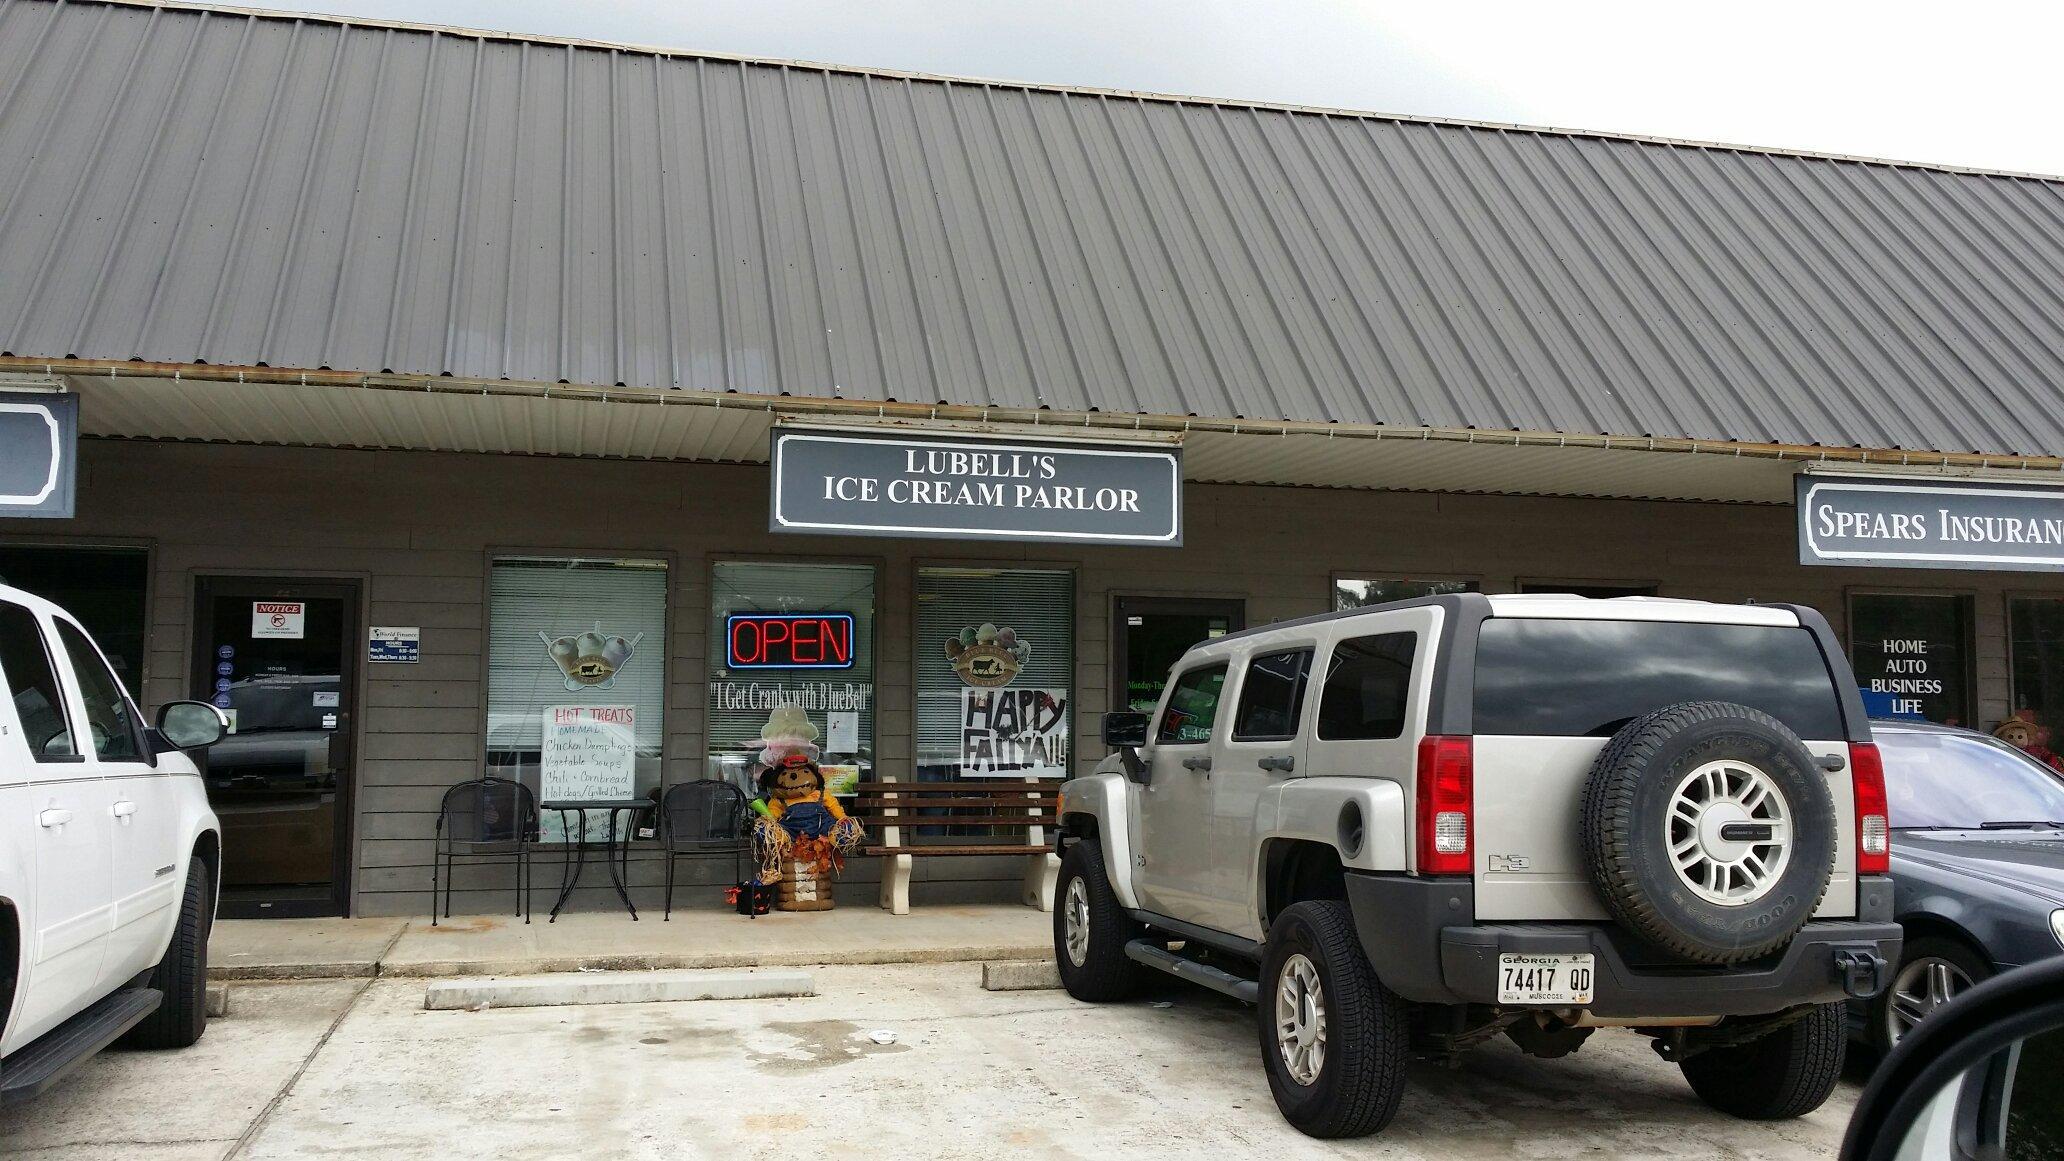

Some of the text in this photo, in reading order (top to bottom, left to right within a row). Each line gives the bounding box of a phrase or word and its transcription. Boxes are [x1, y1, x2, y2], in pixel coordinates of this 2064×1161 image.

[904, 449, 1056, 480] LUBELL'S
[822, 475, 1141, 513] ICE CREAM PARLOR
[1818, 504, 2064, 545] SPEARS INSURAN
[258, 604, 300, 613] NOTICE
[732, 620, 847, 663] OPEN
[1883, 639, 1927, 654] HOME
[1885, 659, 1927, 673] AUTO
[1871, 678, 1942, 694] BUSINESS
[725, 683, 747, 710] Get
[965, 689, 1067, 735] HAPPY
[1892, 698, 1923, 714] LIFE
[555, 708, 633, 723] HOT TREATS
[545, 739, 581, 752] Chicken
[544, 755, 585, 769] Vegetable
[580, 771, 628, 784] Cornbread
[1488, 854, 1529, 871] H3
[1504, 968, 1590, 991] 74417 QD
